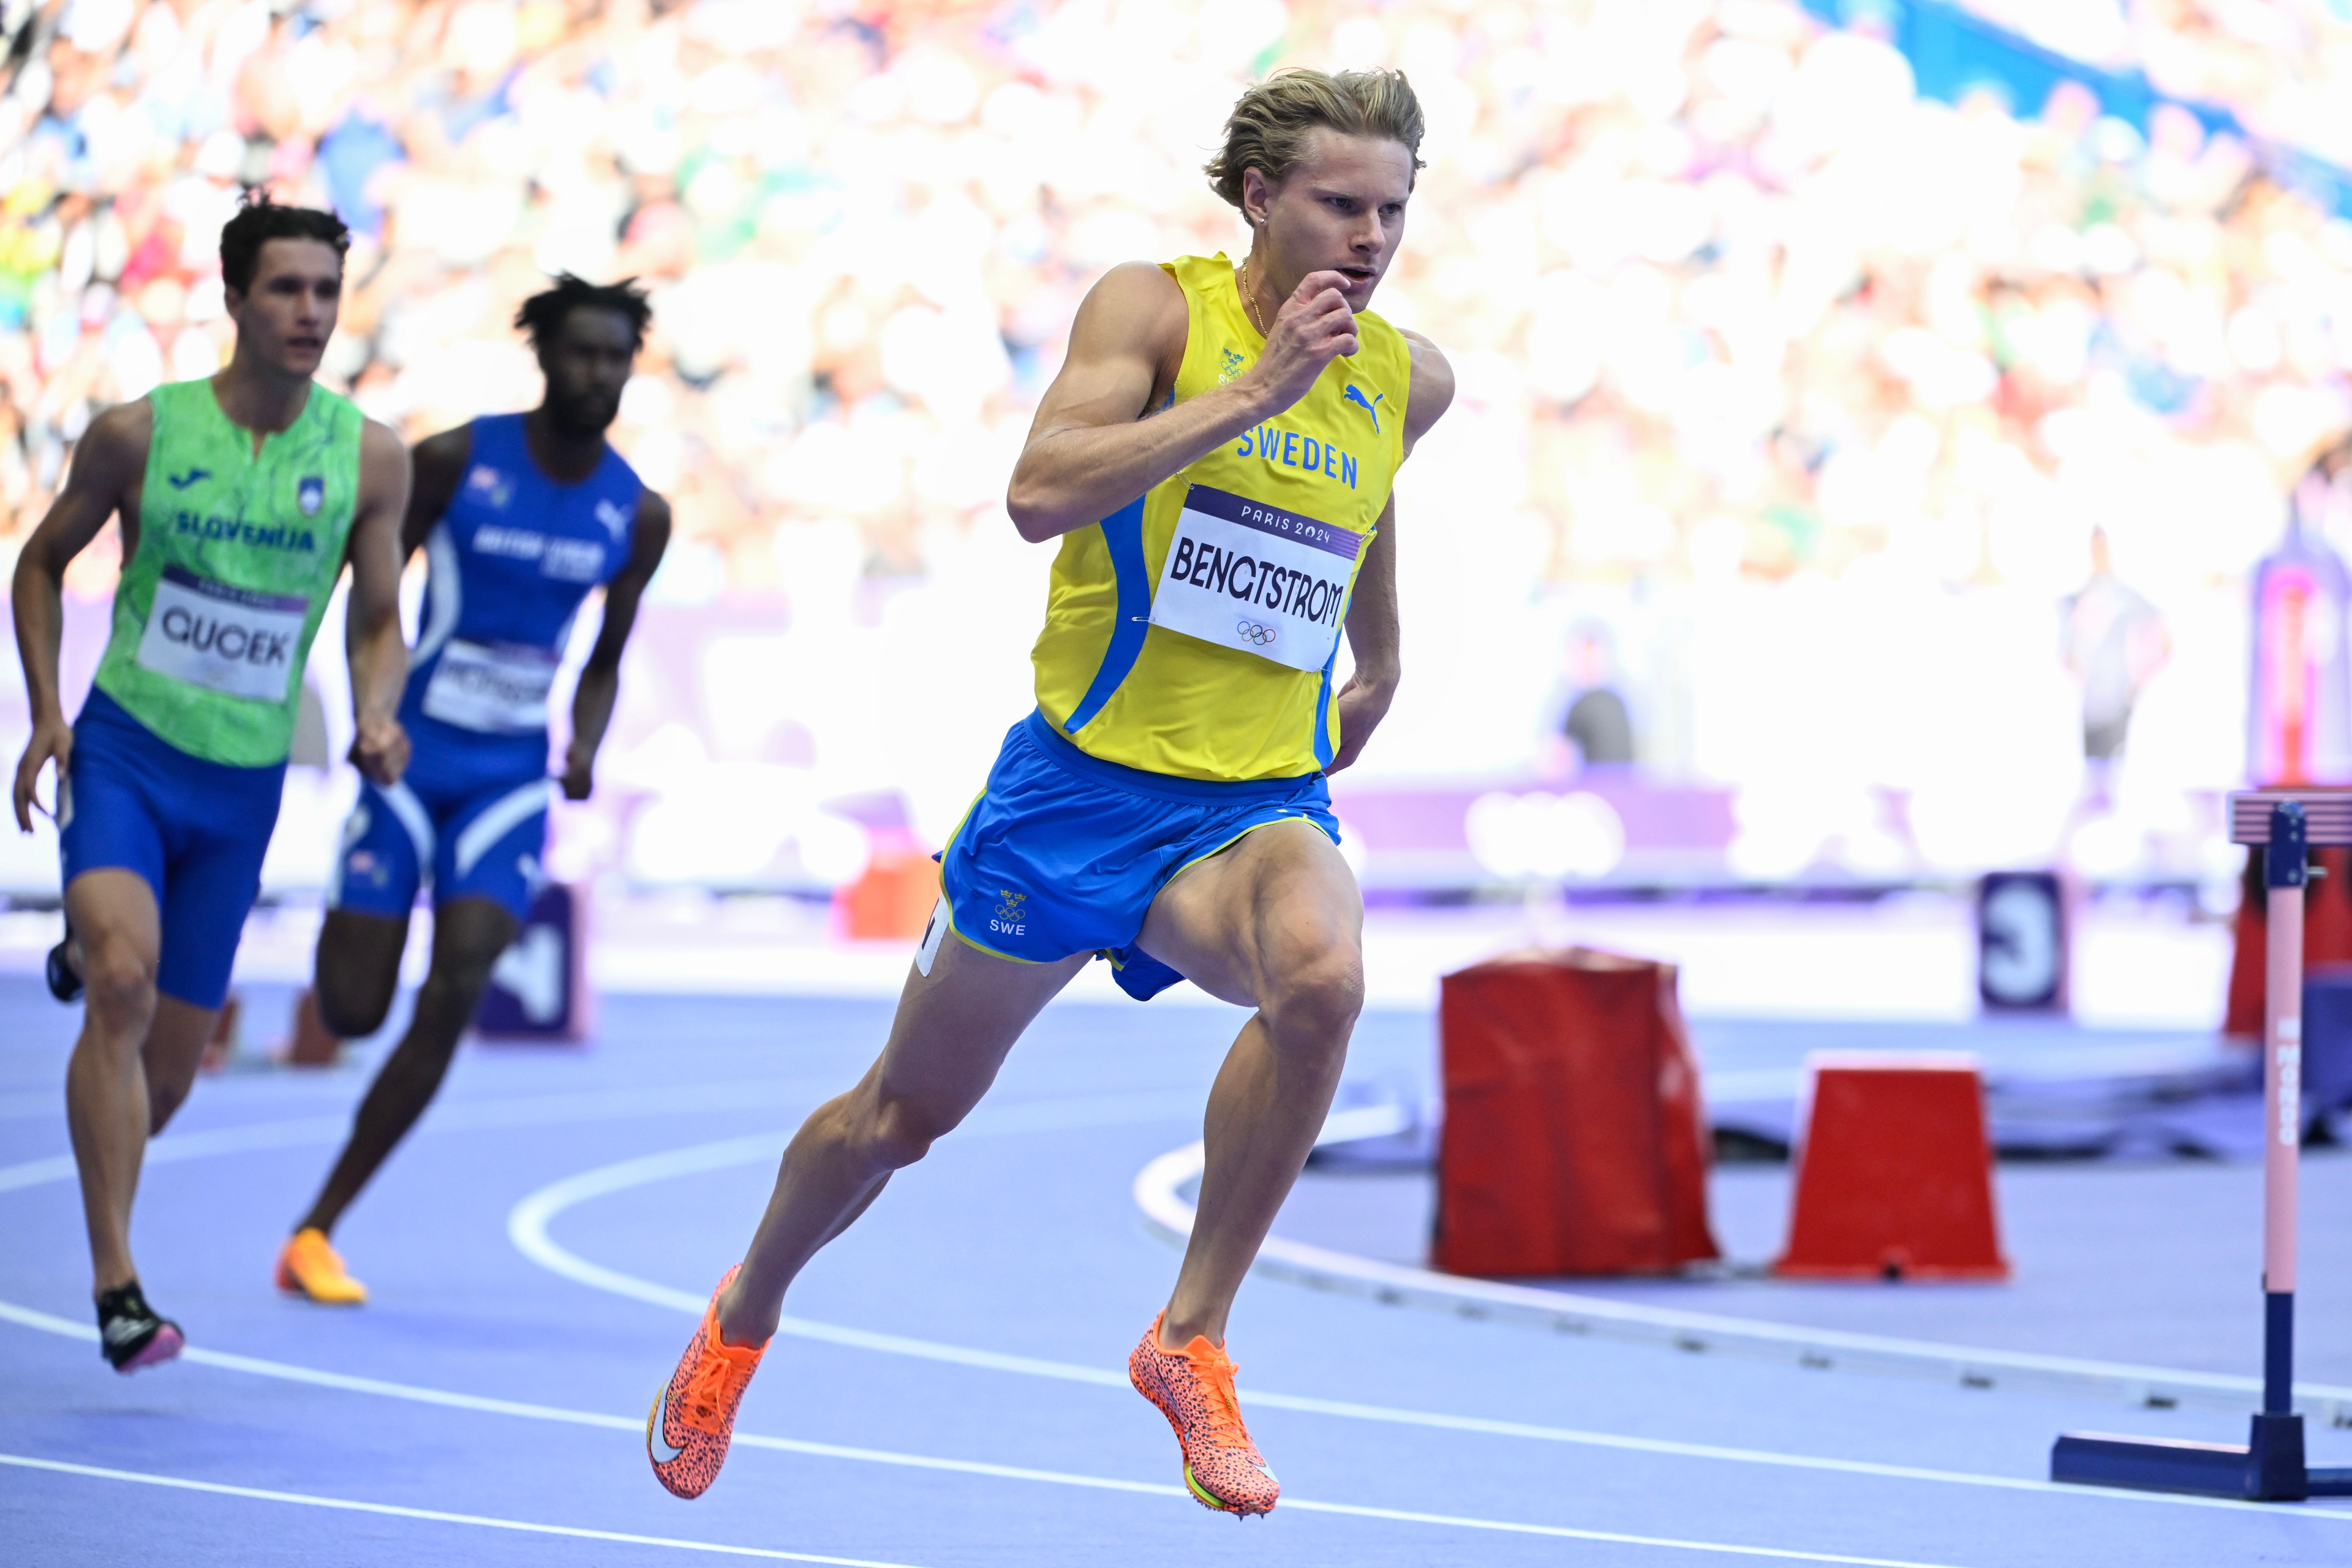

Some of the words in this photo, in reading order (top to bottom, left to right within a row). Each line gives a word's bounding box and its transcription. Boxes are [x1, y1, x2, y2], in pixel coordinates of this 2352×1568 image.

[1237, 426, 1357, 489] SWEDEN
[1294, 522, 1330, 543] 2024
[1170, 537, 1344, 628] BENGTSTROM
[989, 919, 1026, 936] SWE
[1985, 886, 2054, 999] 3
